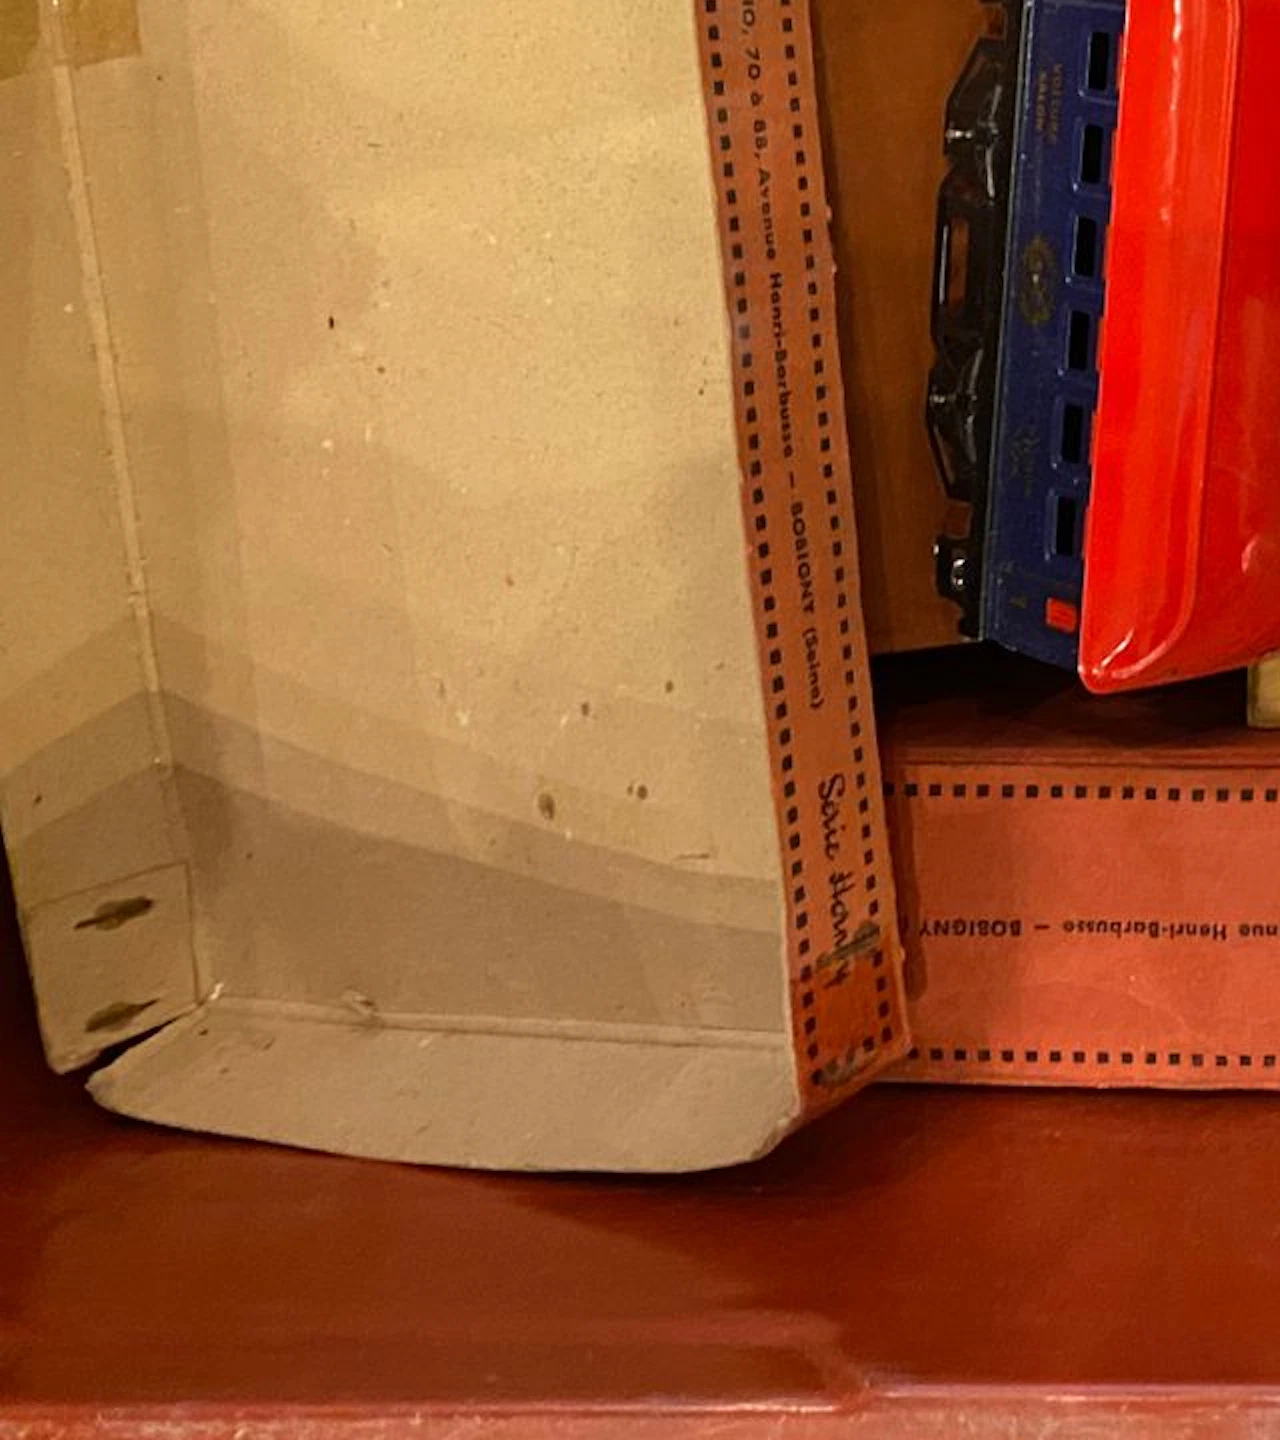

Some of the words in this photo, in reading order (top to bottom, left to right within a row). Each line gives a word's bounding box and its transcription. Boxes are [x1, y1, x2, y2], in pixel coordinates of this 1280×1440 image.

[745, 46, 761, 81] 70
[757, 168, 777, 260] Avenue
[769, 271, 795, 459] Henri-Barbusse
[791, 500, 815, 614] BOBIGNY
[802, 625, 825, 710] (Seine)
[823, 871, 856, 990] Horny
[918, 918, 1023, 939] BOBIGNY
[1062, 920, 1228, 941] Henri-Barbusse
